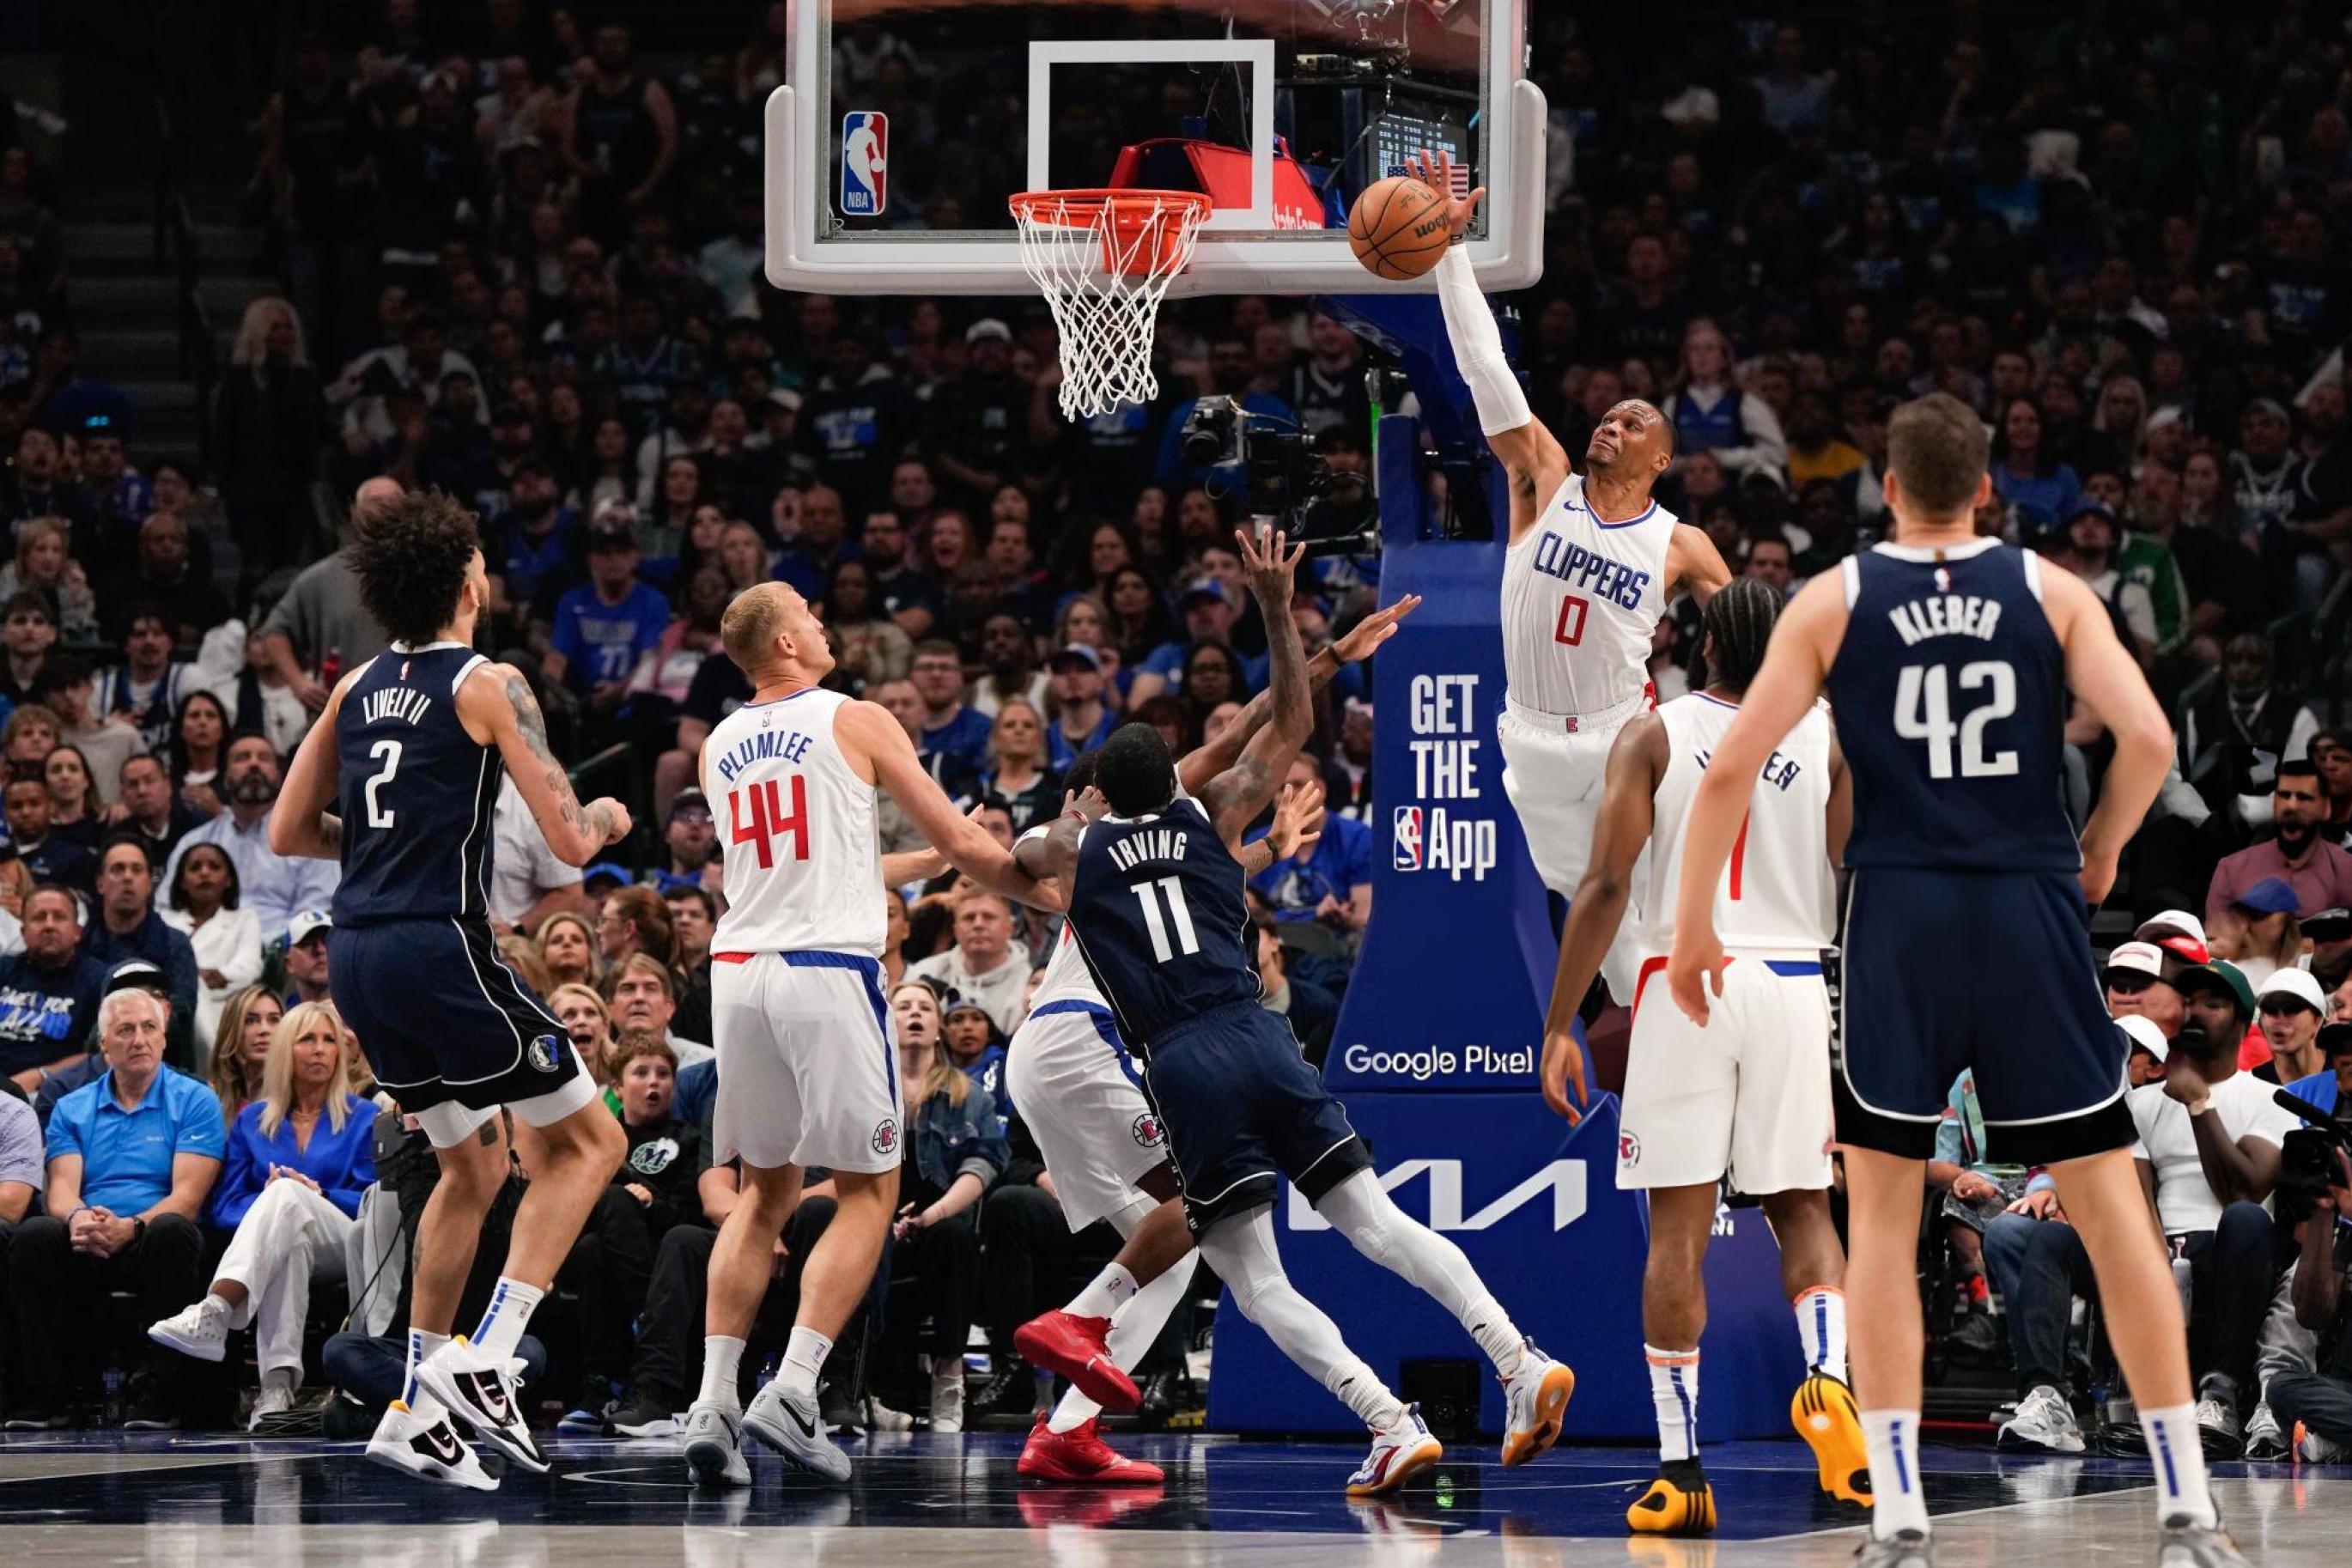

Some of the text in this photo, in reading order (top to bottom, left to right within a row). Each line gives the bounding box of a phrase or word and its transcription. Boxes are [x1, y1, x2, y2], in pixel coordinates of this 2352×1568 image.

[847, 191, 869, 209] NBA
[1534, 530, 1650, 611] CLIPPERS
[1555, 594, 1589, 647] 0
[1888, 594, 2002, 646] KLEBER
[362, 687, 431, 726] LIVELY II
[1411, 674, 1480, 734] GET
[1893, 659, 2020, 779] 42
[364, 739, 403, 829] 2
[717, 730, 813, 782] PLUMLEE
[1409, 740, 1480, 799] THE
[727, 775, 809, 869] 44
[1107, 830, 1188, 872] IRVING
[1427, 807, 1496, 882] App
[1130, 875, 1200, 963] 11
[1345, 1044, 1534, 1081] Google Pixel
